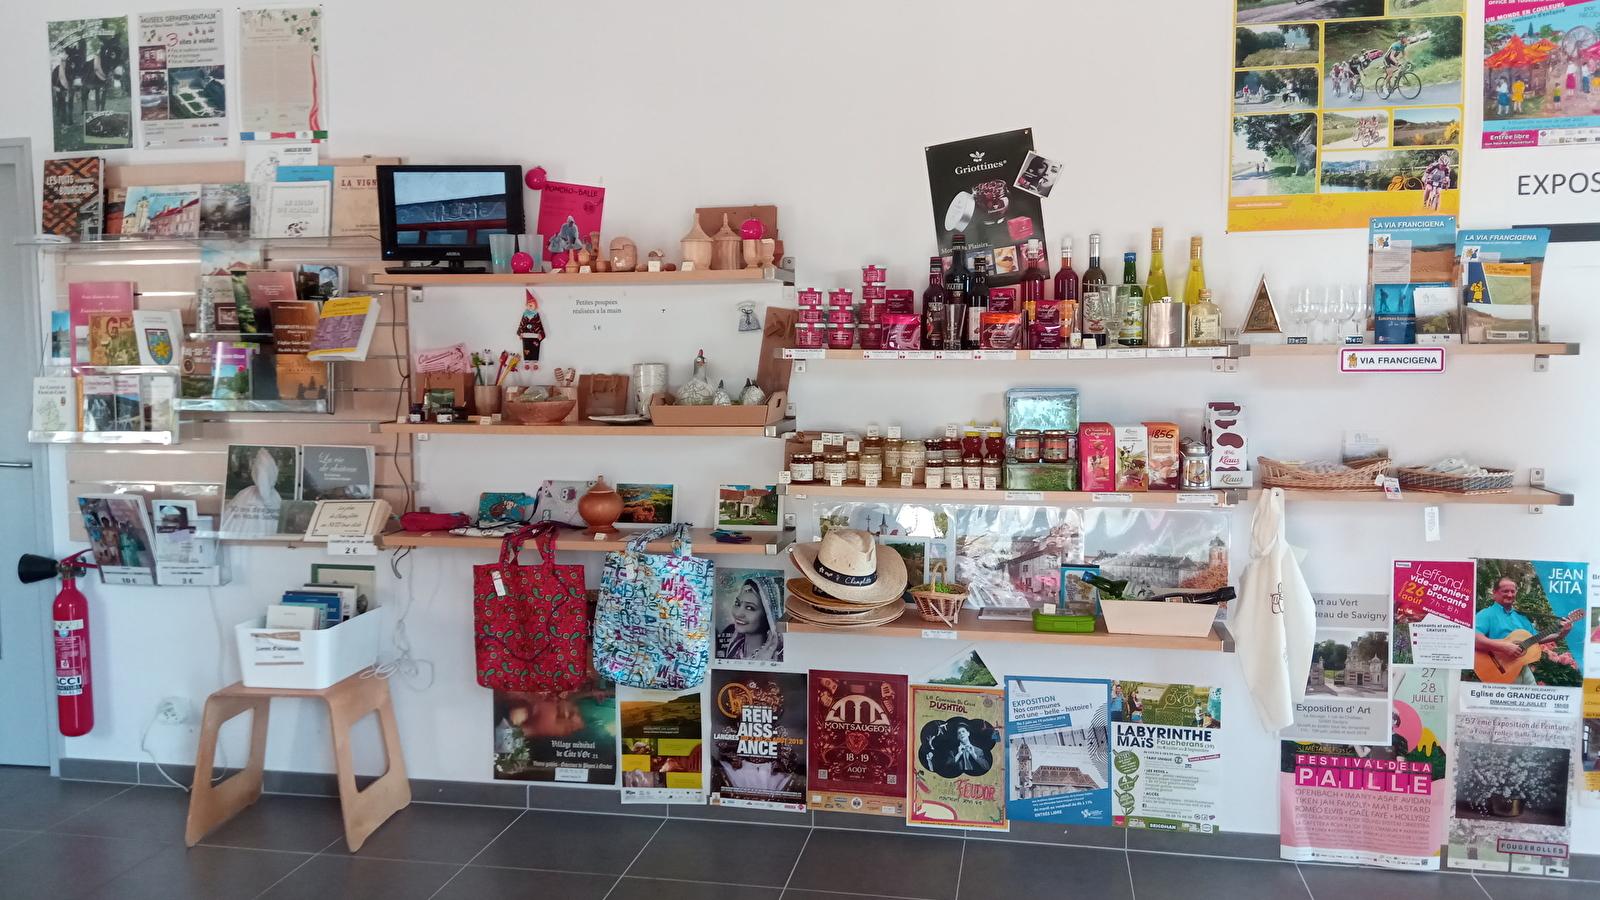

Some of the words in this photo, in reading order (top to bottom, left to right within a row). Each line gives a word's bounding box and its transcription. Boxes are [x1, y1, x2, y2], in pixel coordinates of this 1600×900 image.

[1497, 12, 1520, 21] MONDE
[1532, 2, 1565, 13] COULEURS
[1512, 14, 1536, 23] couleurs
[166, 33, 178, 47] 3
[955, 162, 1003, 175] Griottines
[1518, 172, 1600, 195] EXPOS
[59, 184, 94, 195] BOURGOGNE
[1150, 430, 1175, 439] 1856
[319, 463, 328, 472] de
[330, 464, 357, 472] château
[1220, 473, 1244, 482] Klaus
[1416, 563, 1462, 590] Leffond
[1548, 569, 1584, 581] JEAN
[845, 577, 872, 586] Champlitte
[1406, 582, 1425, 597] 26
[1410, 574, 1470, 602] vide-greniers
[1549, 581, 1582, 594] KITA
[1313, 598, 1324, 606] Art
[1401, 594, 1422, 605] août
[1427, 588, 1467, 608] brocante
[1315, 605, 1335, 613] teau
[1351, 606, 1387, 617] Savigny
[1421, 668, 1436, 678] 27
[1420, 683, 1436, 693] 28
[1412, 695, 1444, 703] JUILLET
[1471, 690, 1493, 699] Eglise
[1507, 693, 1569, 701] GRANDECOURT
[1012, 696, 1056, 707] EXPOSITION
[1027, 703, 1060, 712] communes
[1045, 708, 1060, 716] belle
[1065, 705, 1088, 713] histoire
[1296, 704, 1343, 714] Exposition
[742, 709, 778, 723] REN-
[824, 722, 891, 733] MONTSAUGEON
[1492, 720, 1529, 728] Exposition
[738, 722, 778, 738] AISS-
[1117, 724, 1211, 742] LABYRINTHE
[551, 740, 571, 749] Village
[737, 740, 777, 756] ANCE
[1157, 739, 1203, 748] Foucherans
[846, 753, 854, 762] 18
[861, 754, 869, 762] 19
[1298, 755, 1383, 769] FESTIVAL
[1388, 761, 1406, 771] DE
[1412, 764, 1431, 773] LA
[1299, 768, 1428, 794] PAILLE
[1295, 789, 1338, 798] OFENBACH
[1295, 797, 1318, 805] TIKEN
[1336, 800, 1367, 809] FAKOLY
[1393, 805, 1430, 814] BASTARD
[1295, 806, 1322, 814] ROMÉO
[1395, 814, 1430, 822] HOLLYSIZ
[1501, 841, 1563, 852] FOUGEROLLES
